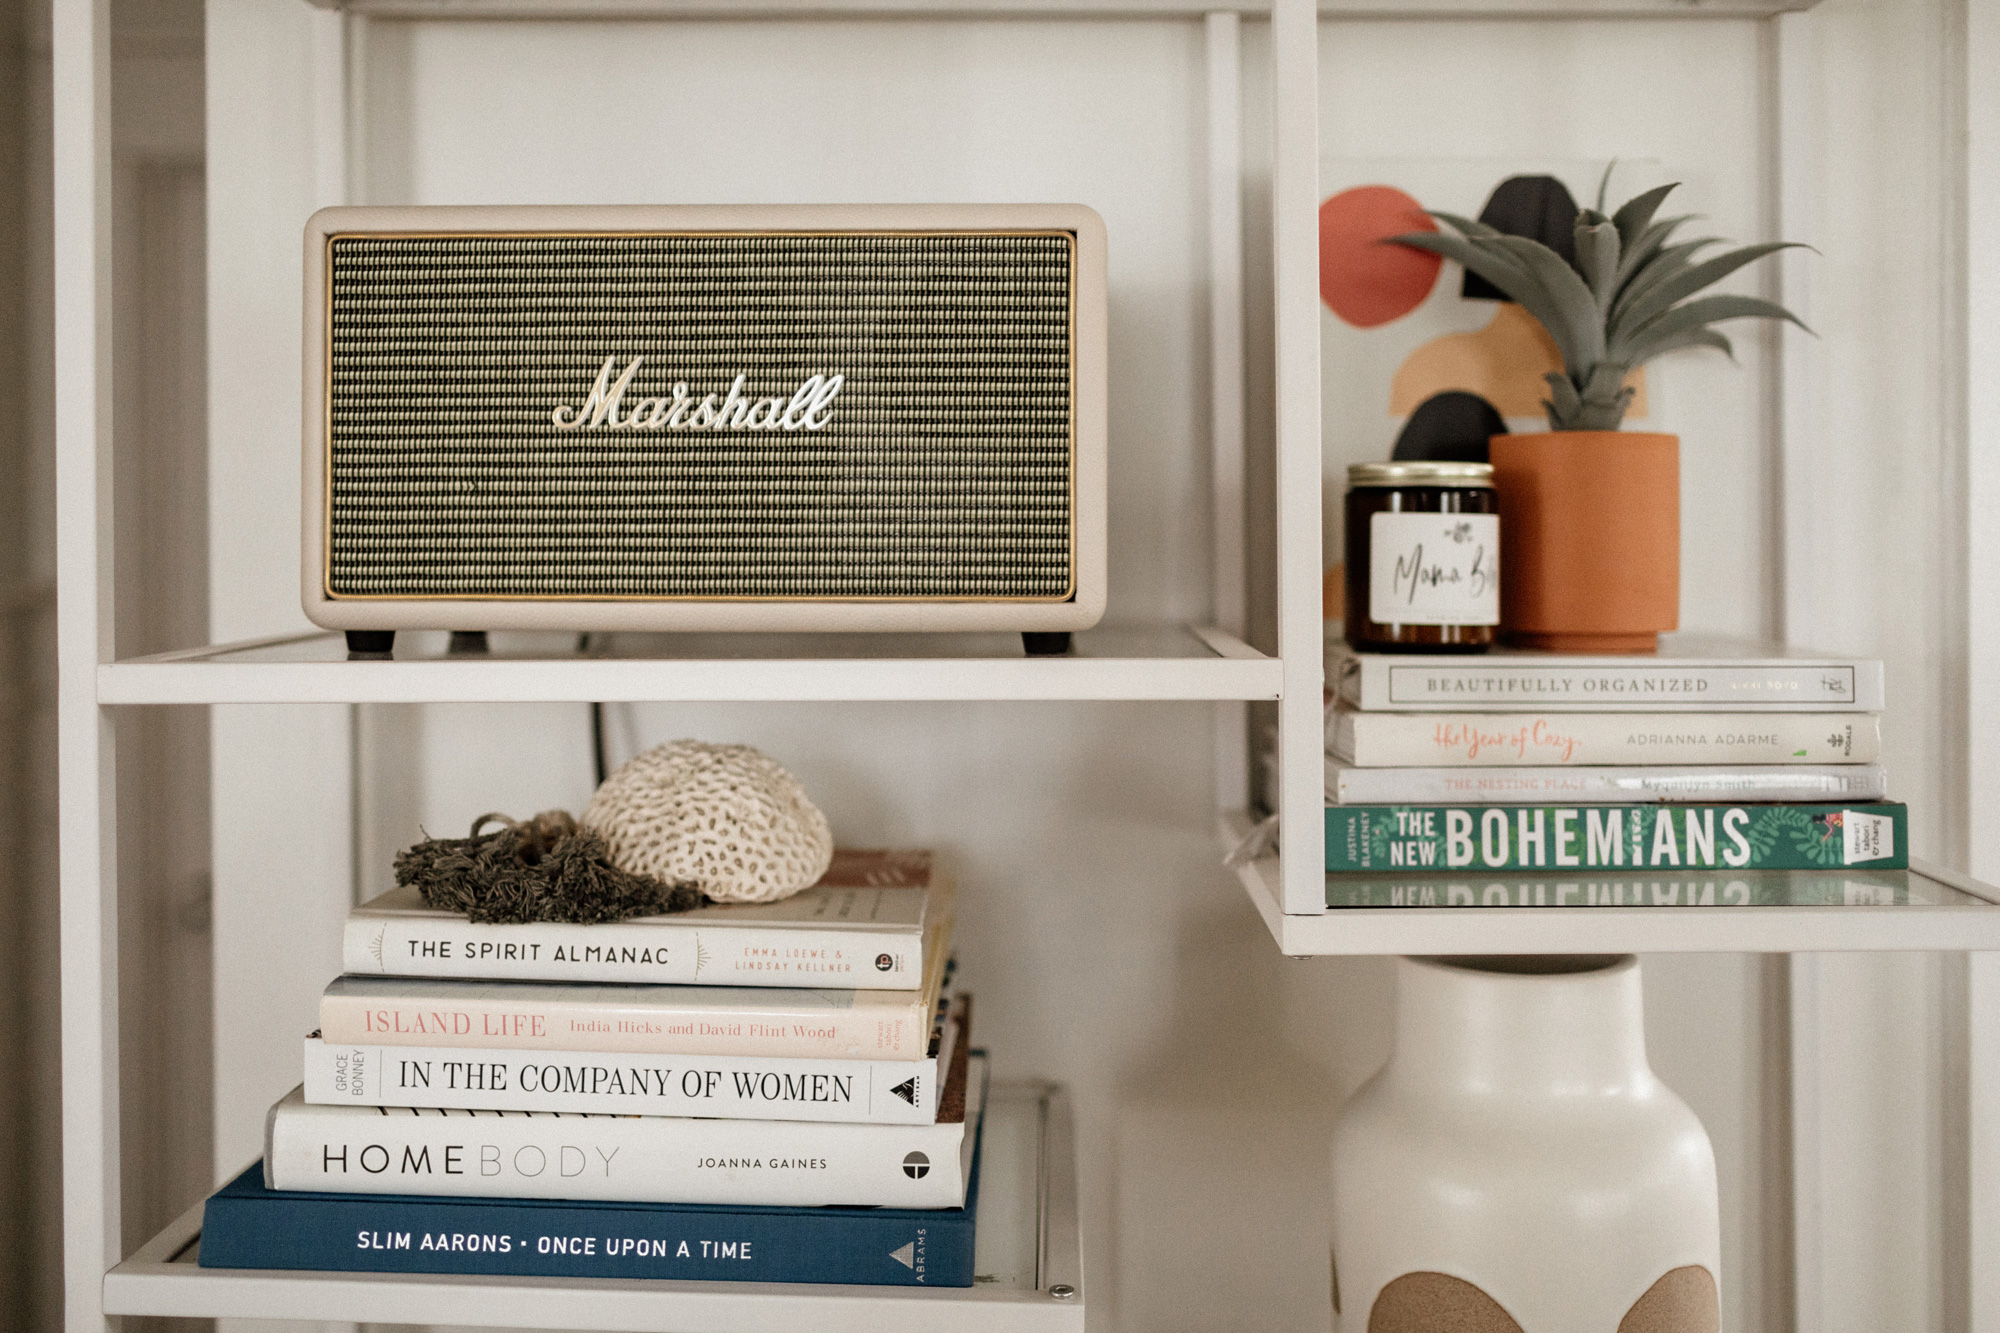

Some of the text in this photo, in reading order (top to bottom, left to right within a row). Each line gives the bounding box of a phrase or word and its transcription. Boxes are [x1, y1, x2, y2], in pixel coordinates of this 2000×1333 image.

[552, 355, 844, 431] Marshall
[1428, 678, 1708, 692] BEAUTIFULLY ORGANIZED
[1511, 726, 1528, 758] of
[1627, 734, 1779, 745] ADRIANNA ADARME
[1444, 778, 1471, 790] THE
[1478, 778, 1539, 790] NESTING
[1716, 779, 1756, 791] Smith
[1395, 811, 1436, 837] THE
[1871, 819, 1882, 846] chang
[1348, 817, 1356, 862] JUSTINA
[1361, 811, 1371, 868] BLAKENEY
[1446, 808, 1750, 867] BOHEMIANS
[1862, 825, 1870, 851] tabori
[1390, 841, 1436, 867] NEW
[408, 940, 669, 965] THE SPIRIT ALMANAC
[744, 947, 842, 959] EMMA LOEWE &
[735, 961, 851, 973] LINDSAY KELLNER
[365, 1010, 547, 1038] ISLAND LIFE
[570, 1019, 836, 1039] India Hicks and David Flint Wood
[335, 1053, 348, 1092] GRACE
[352, 1049, 365, 1096] BONNEY
[399, 1061, 854, 1103] IN THE COMPANY OF WOMEN
[697, 1157, 827, 1170] JOANNA GAINES
[357, 1231, 752, 1260] SLIM AARONS ONCE UPON A TIME
[915, 1228, 927, 1283] ABRAMS
